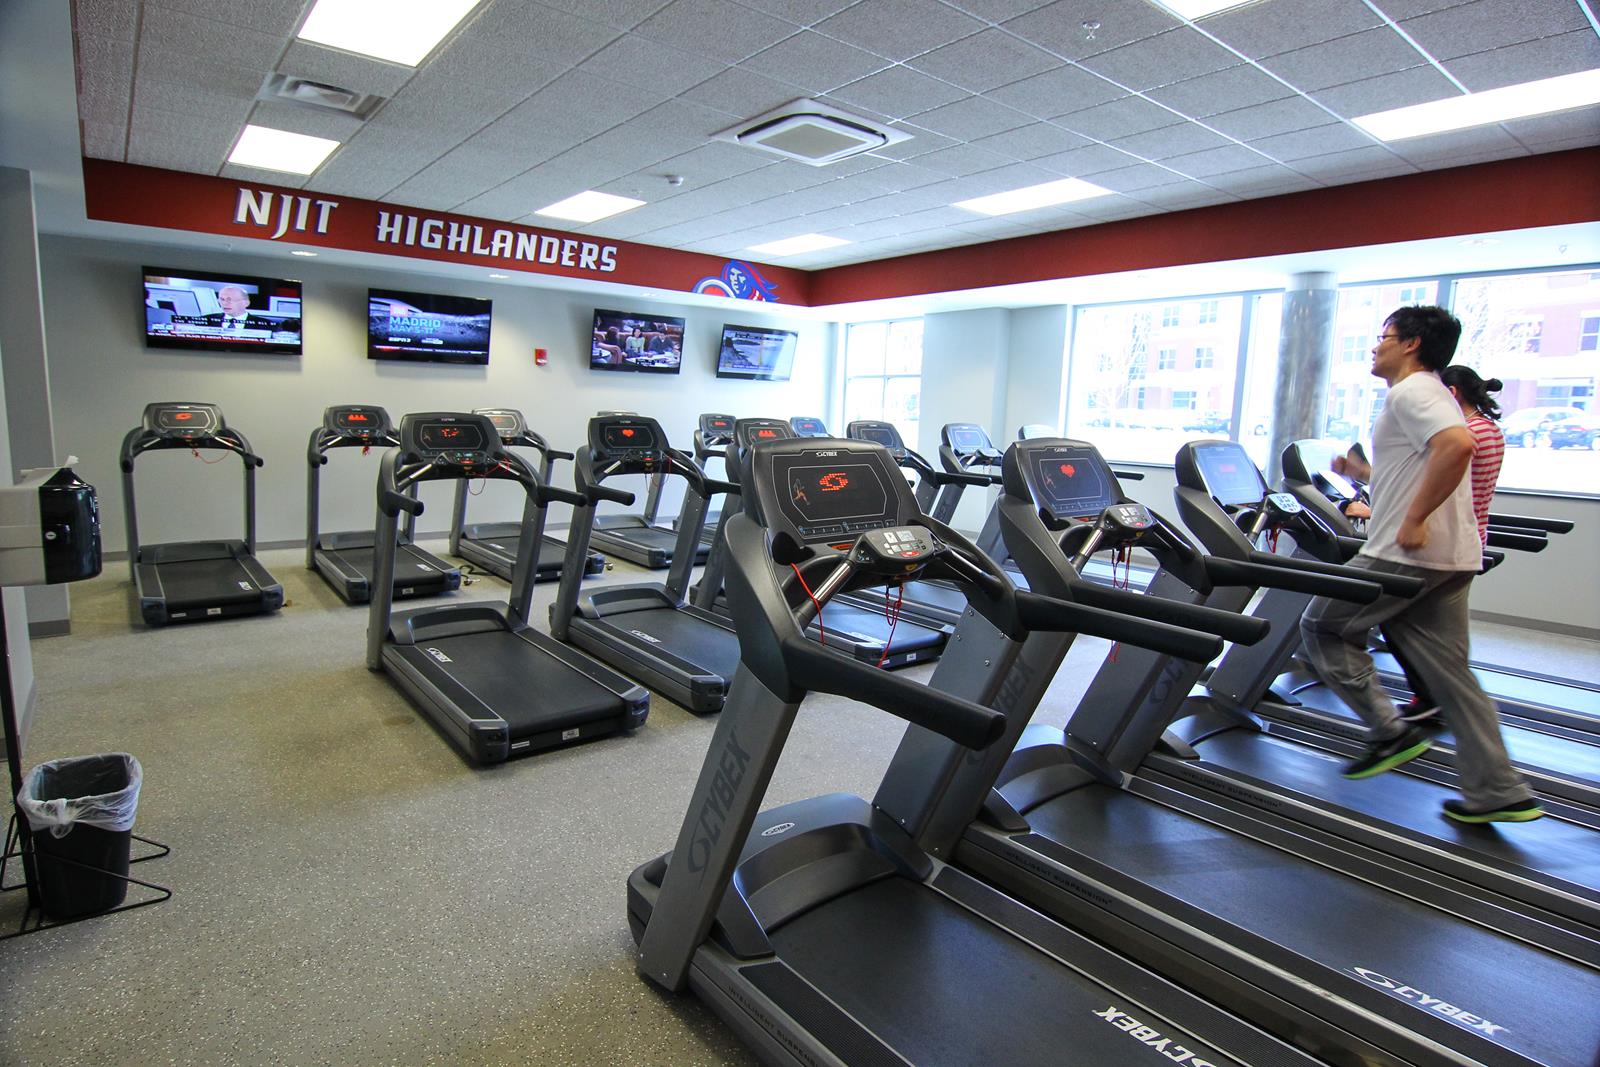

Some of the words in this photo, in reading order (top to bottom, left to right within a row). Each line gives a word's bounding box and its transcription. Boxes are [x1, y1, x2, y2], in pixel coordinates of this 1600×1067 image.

[233, 187, 339, 240] NJIT
[376, 210, 619, 273] HIGHLANDERS
[389, 316, 441, 328] MADRID
[389, 325, 412, 333] MAY
[700, 728, 750, 846] CYBEX
[1091, 1006, 1196, 1062] CYBEX
[1392, 984, 1505, 1037] CYBEX
